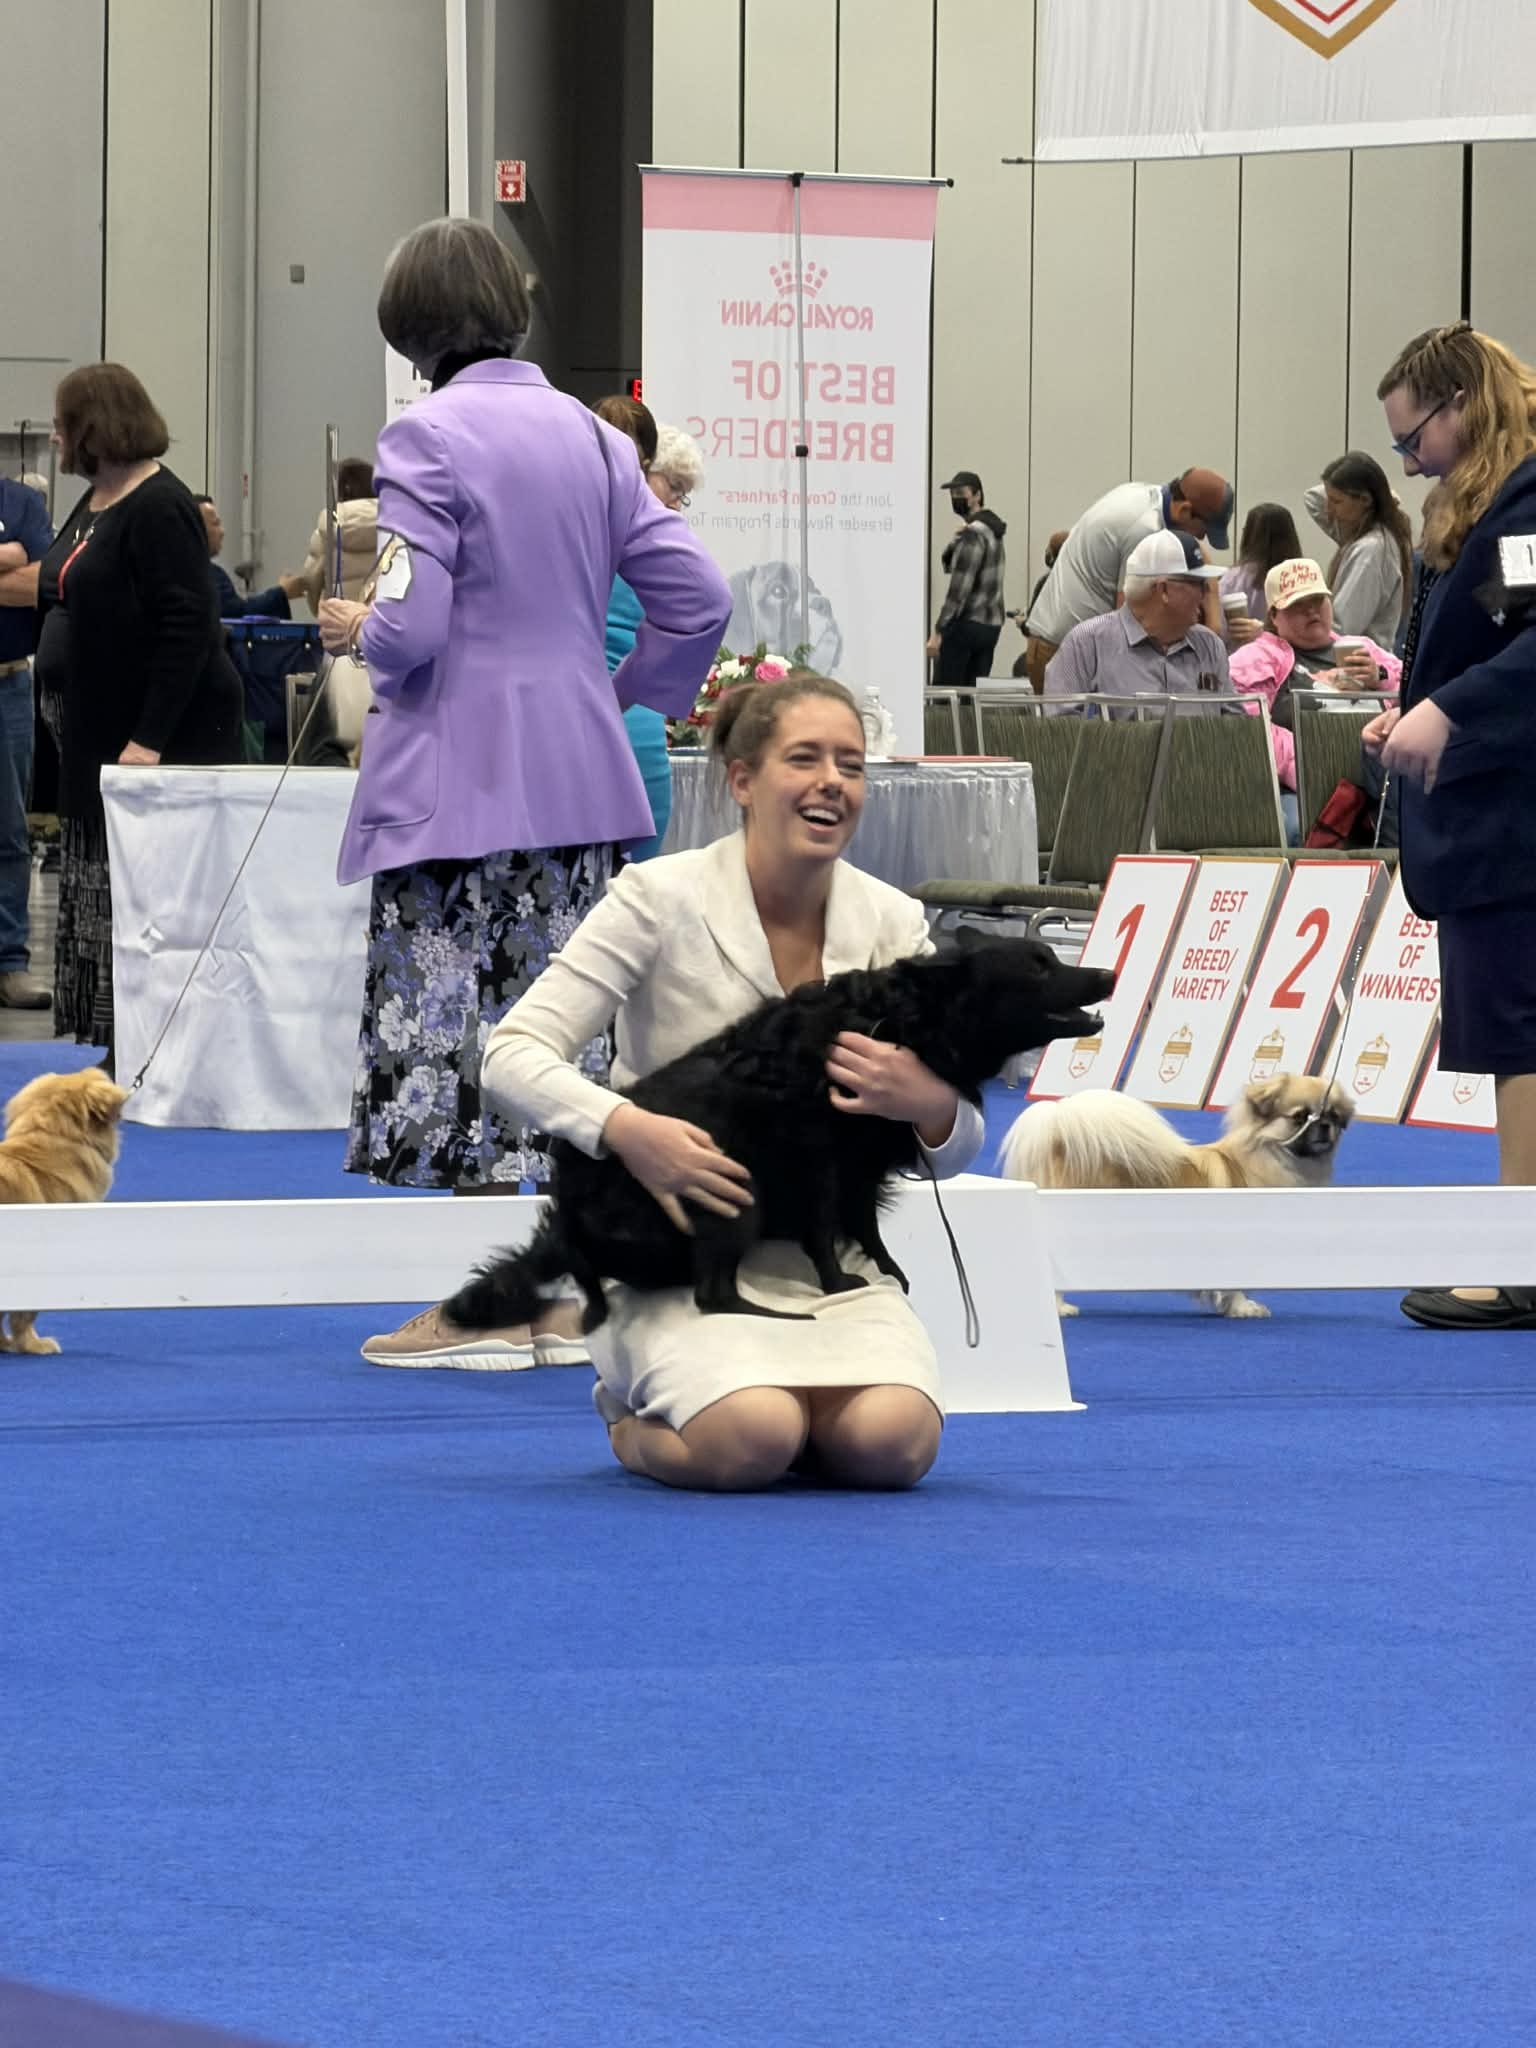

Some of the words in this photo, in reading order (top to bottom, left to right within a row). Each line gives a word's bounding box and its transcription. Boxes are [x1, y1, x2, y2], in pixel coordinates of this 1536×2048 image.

[1209, 889, 1249, 913] BEST
[1208, 919, 1231, 942] OF
[1398, 912, 1438, 938] BES
[1106, 903, 1146, 1003] 1
[1182, 947, 1240, 974] BREED/
[1269, 906, 1332, 1010] 2
[1398, 944, 1425, 969] OF
[1171, 975, 1231, 1001] VARIETY
[1359, 972, 1441, 1002] WINNERS
